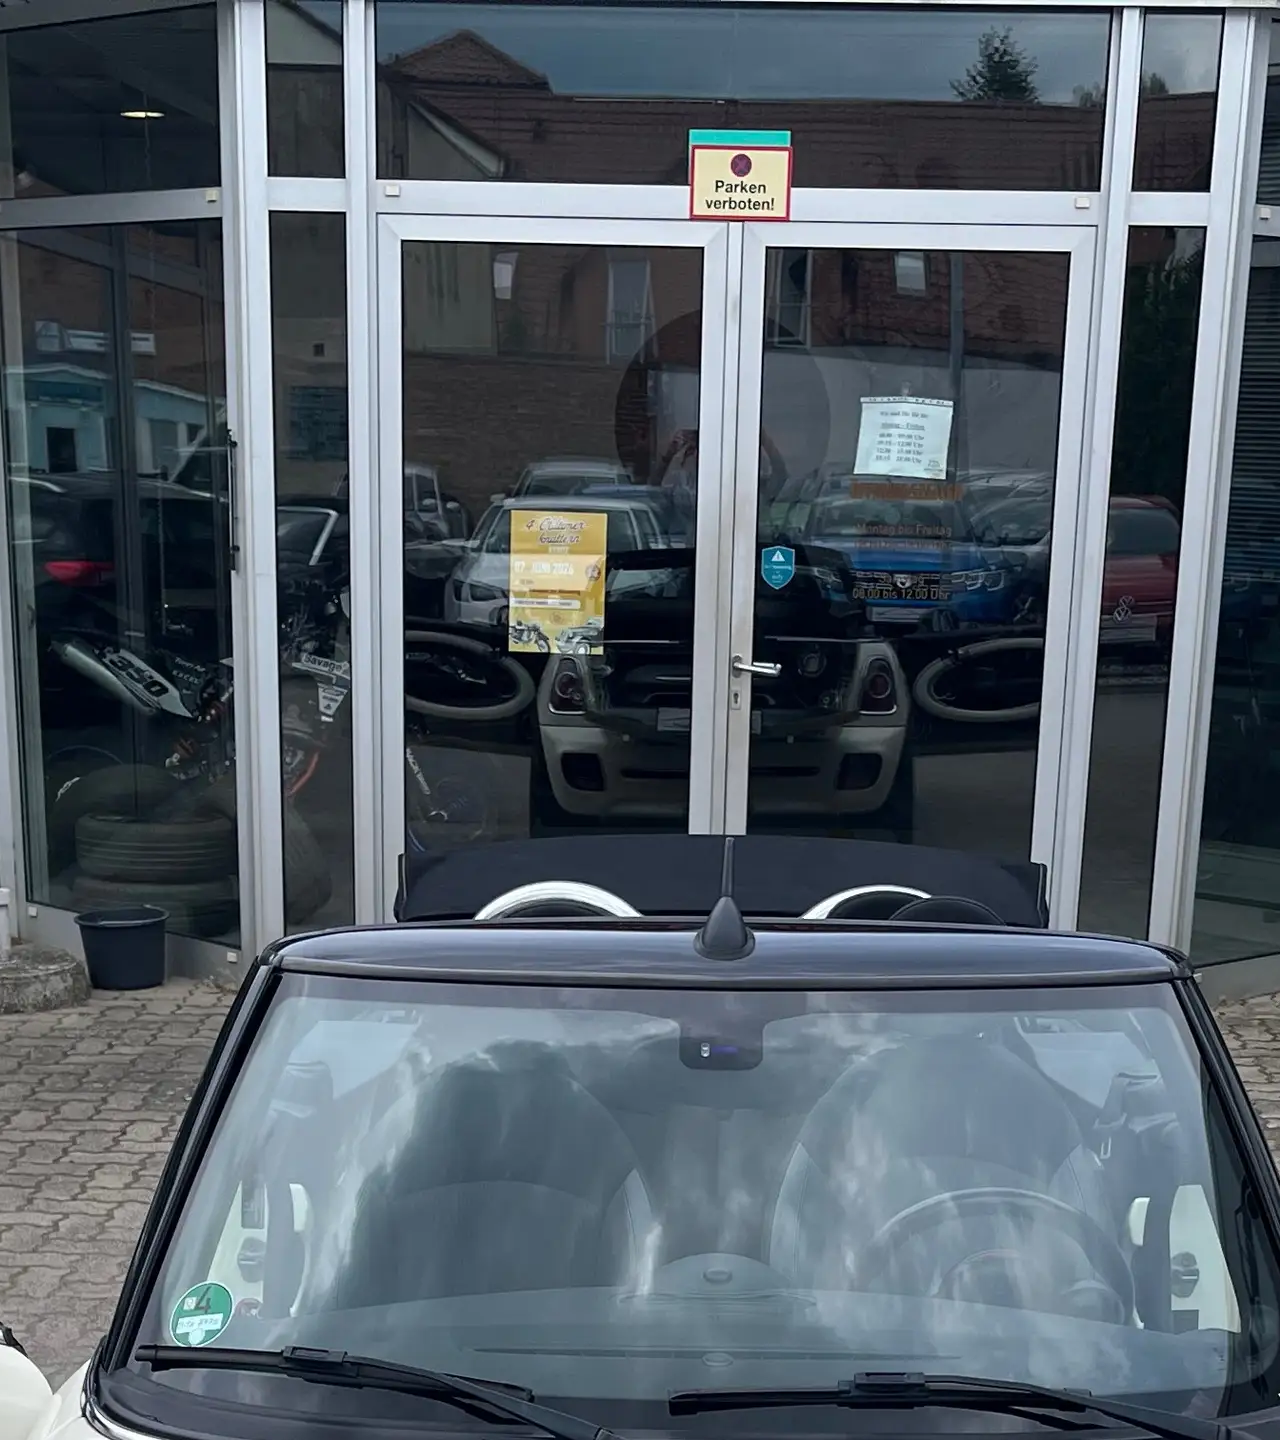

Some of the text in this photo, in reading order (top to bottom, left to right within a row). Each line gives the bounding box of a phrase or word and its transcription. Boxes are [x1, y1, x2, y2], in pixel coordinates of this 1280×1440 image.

[714, 179, 767, 194] Parken
[705, 197, 775, 211] verboten!
[916, 524, 952, 537] Freitag
[882, 589, 898, 600] bis
[901, 589, 928, 600] 12.00
[930, 589, 950, 600] Uhr
[194, 1285, 212, 1314] 4
